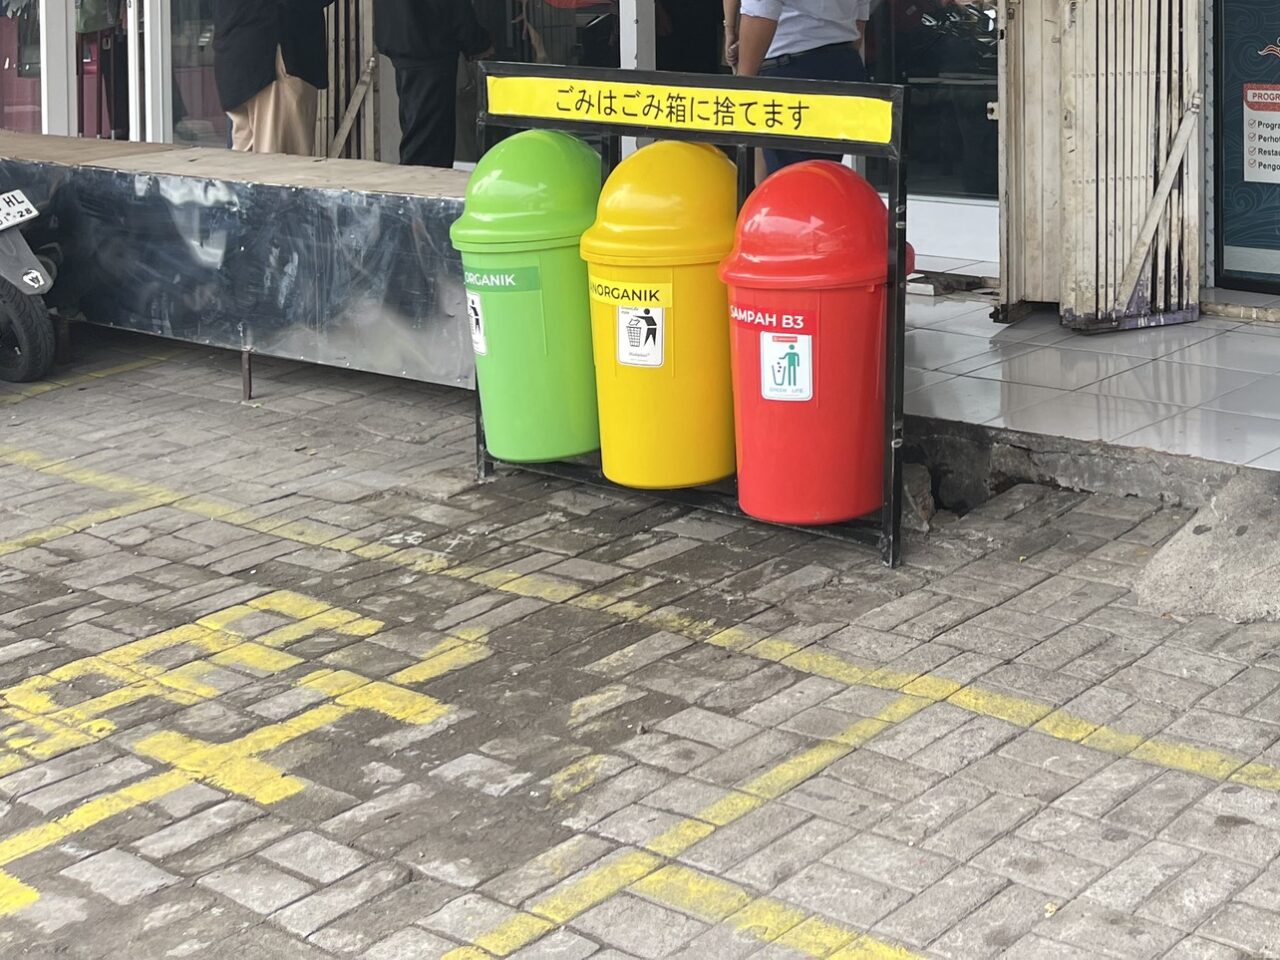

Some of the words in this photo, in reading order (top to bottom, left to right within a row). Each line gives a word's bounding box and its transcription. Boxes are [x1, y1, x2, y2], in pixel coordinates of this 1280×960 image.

[556, 86, 811, 130] ごみはごみ箱に捨てます
[463, 271, 516, 286] ORGANIK
[730, 304, 777, 327] SAMPAH
[782, 314, 804, 329] B3
